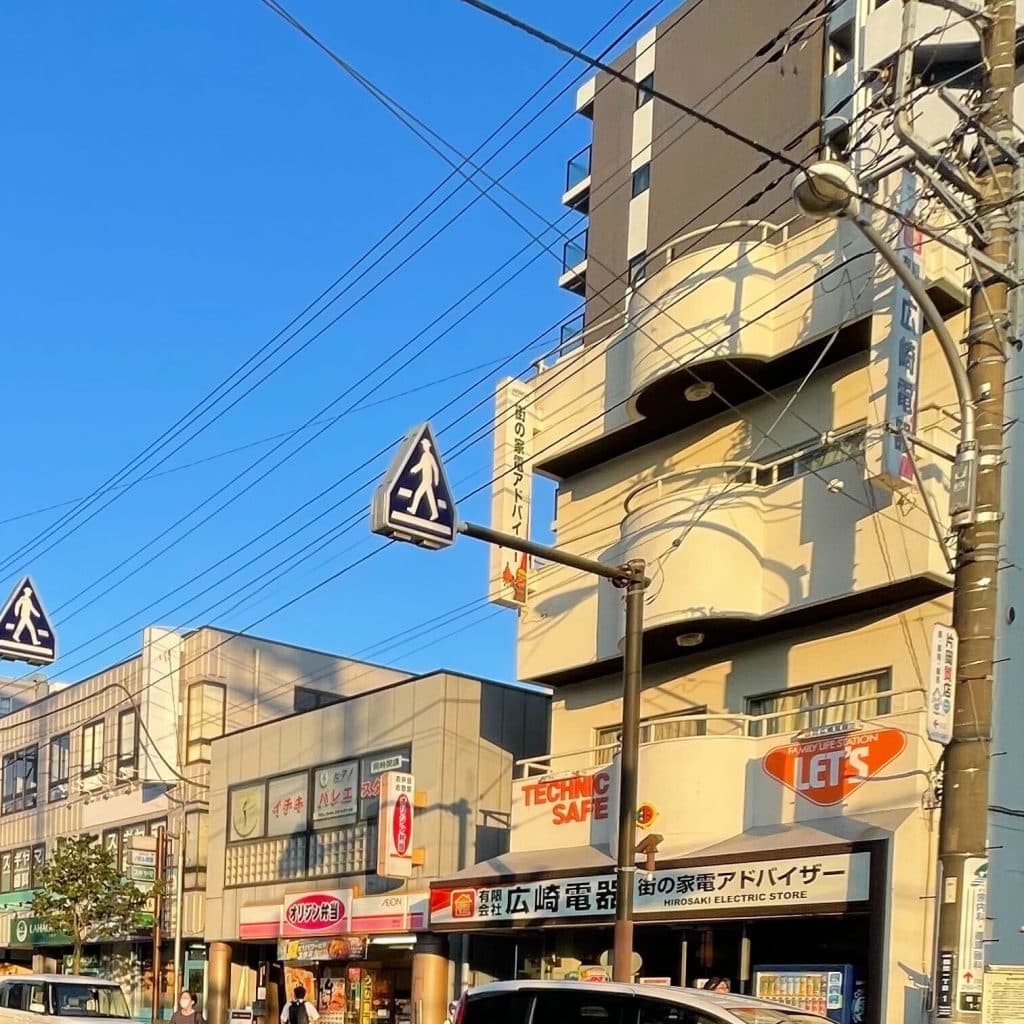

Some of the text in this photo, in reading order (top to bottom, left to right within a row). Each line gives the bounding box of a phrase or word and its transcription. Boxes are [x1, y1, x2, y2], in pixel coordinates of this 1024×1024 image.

[512, 404, 526, 563] 街の家電アドバイー
[788, 733, 880, 754] FAMILY LIFE STATION
[794, 746, 870, 790] LET'S
[522, 772, 610, 806] TECHNIC
[552, 797, 609, 825] SAFE
[637, 864, 845, 897] 街の家電アドバイザー
[478, 889, 502, 903] 有限
[506, 879, 618, 915] 広崎電器
[663, 890, 807, 907] HIROSAKI ELECTRIC STORE
[289, 901, 340, 923] オリジン弁当
[478, 904, 502, 917] 会社
